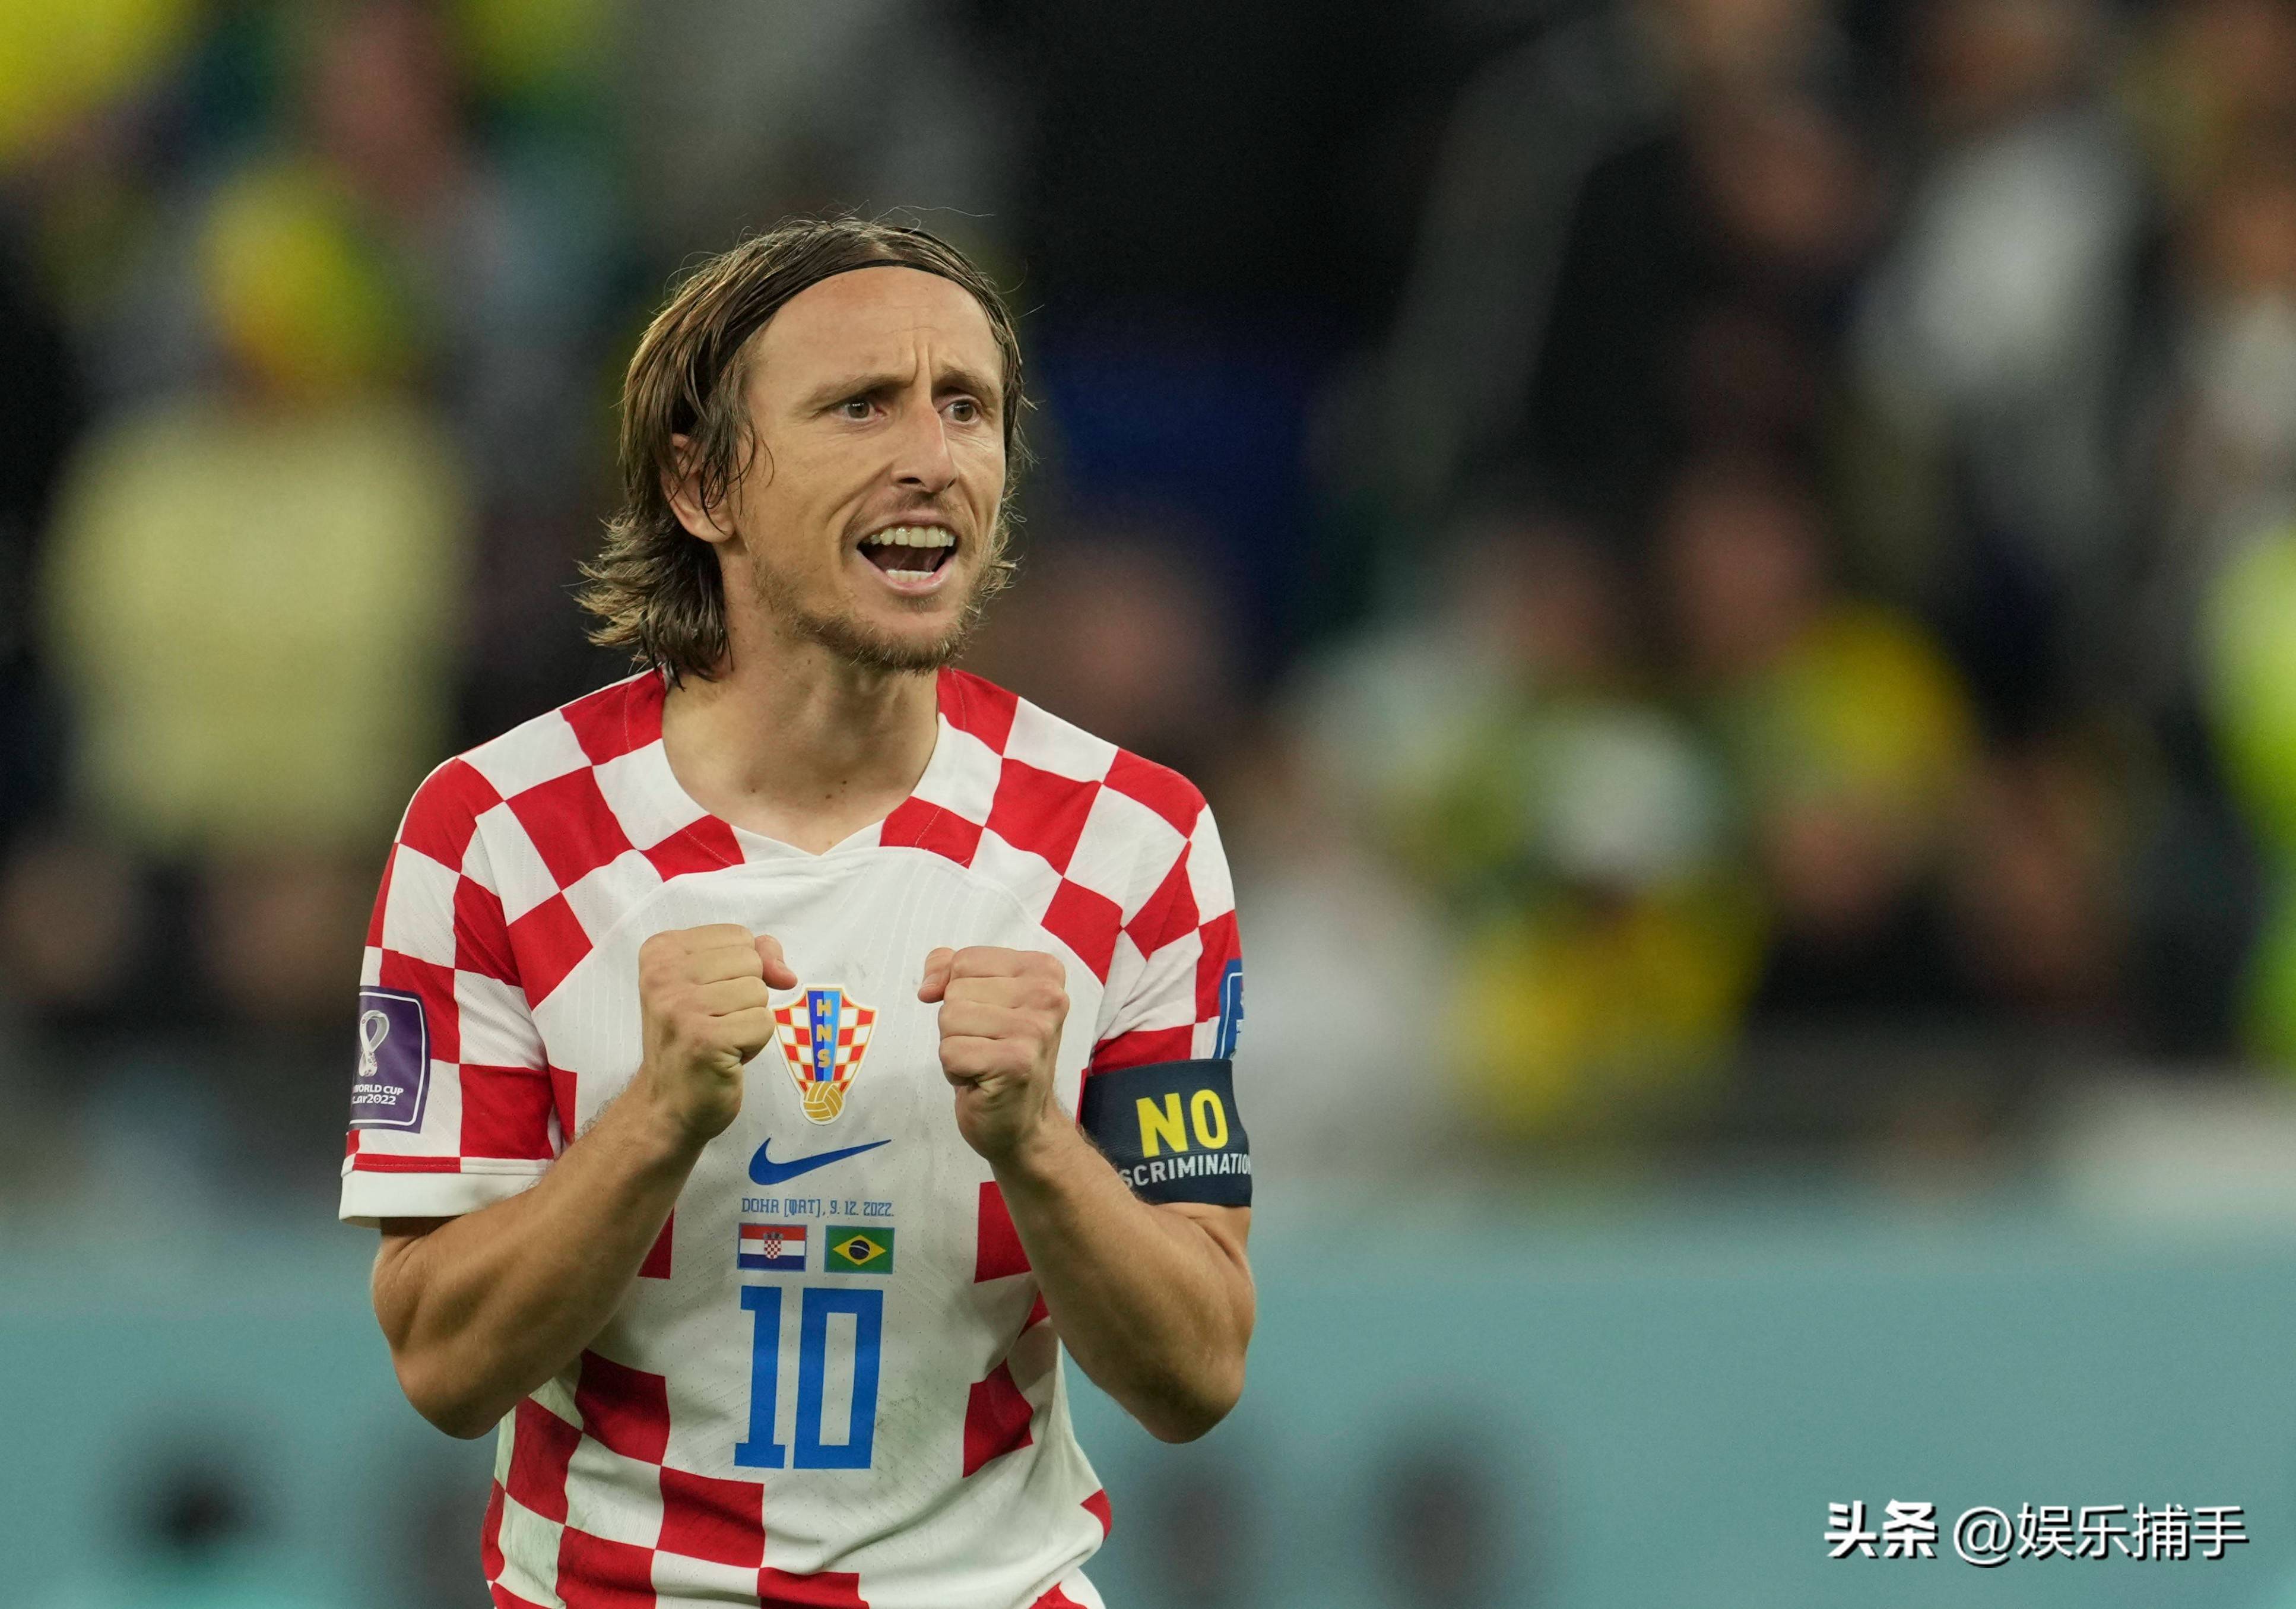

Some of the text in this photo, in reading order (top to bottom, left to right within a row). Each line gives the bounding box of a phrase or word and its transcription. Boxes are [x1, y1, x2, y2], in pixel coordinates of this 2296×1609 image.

[816, 999, 832, 1068] HNS
[383, 1085, 404, 1095] CUP
[1136, 1089, 1229, 1158] NO
[742, 1197, 779, 1214] DOHA
[734, 1285, 883, 1469] 10
